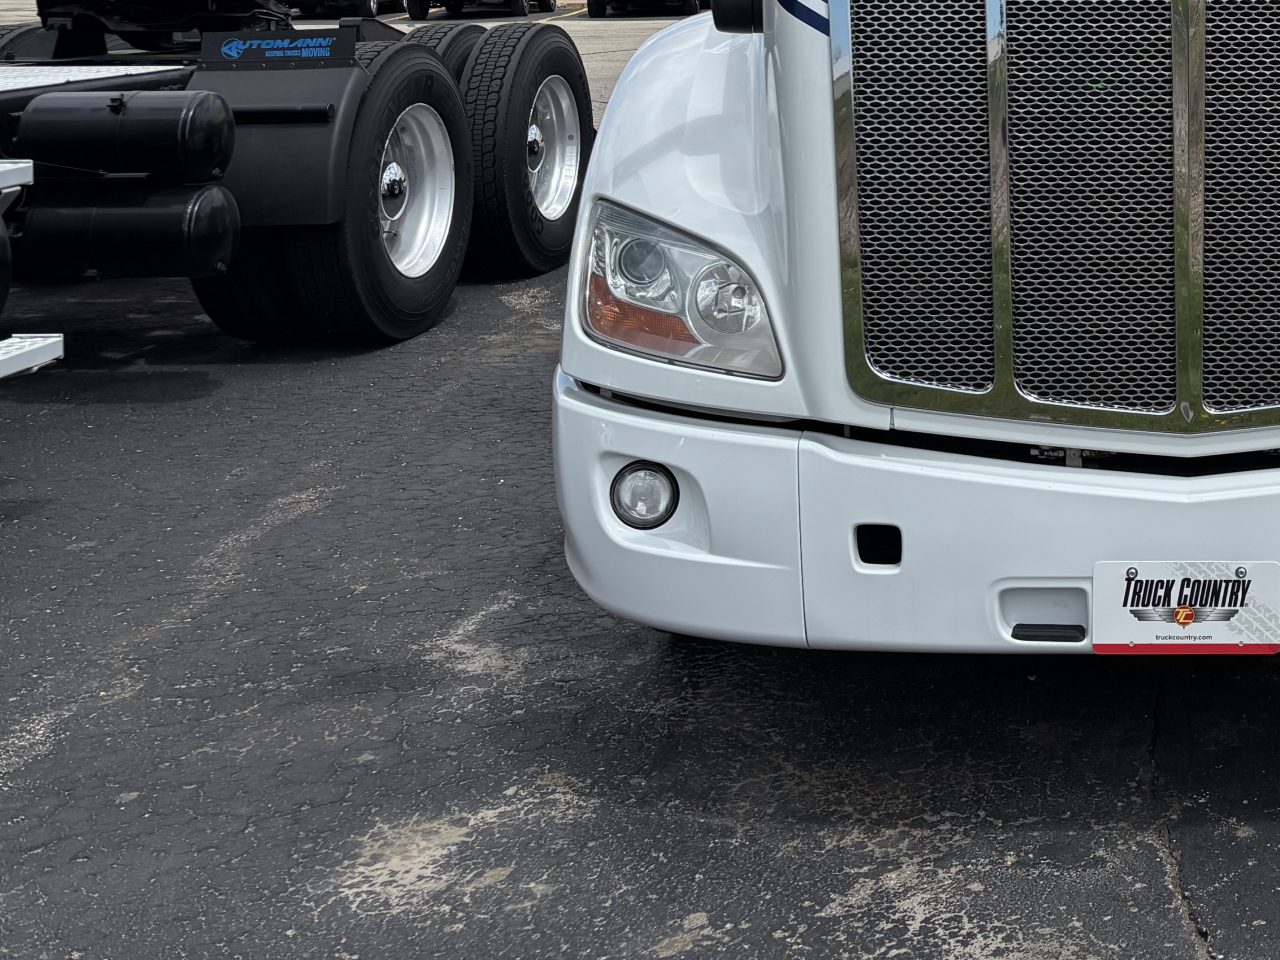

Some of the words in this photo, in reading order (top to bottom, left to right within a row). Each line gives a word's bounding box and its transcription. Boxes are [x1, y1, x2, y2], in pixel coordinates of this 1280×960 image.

[301, 47, 330, 58] MOVING
[1122, 577, 1176, 608] TRUCK
[1177, 577, 1252, 608] COUNTRY
[1155, 633, 1213, 642] truckcountry.com
